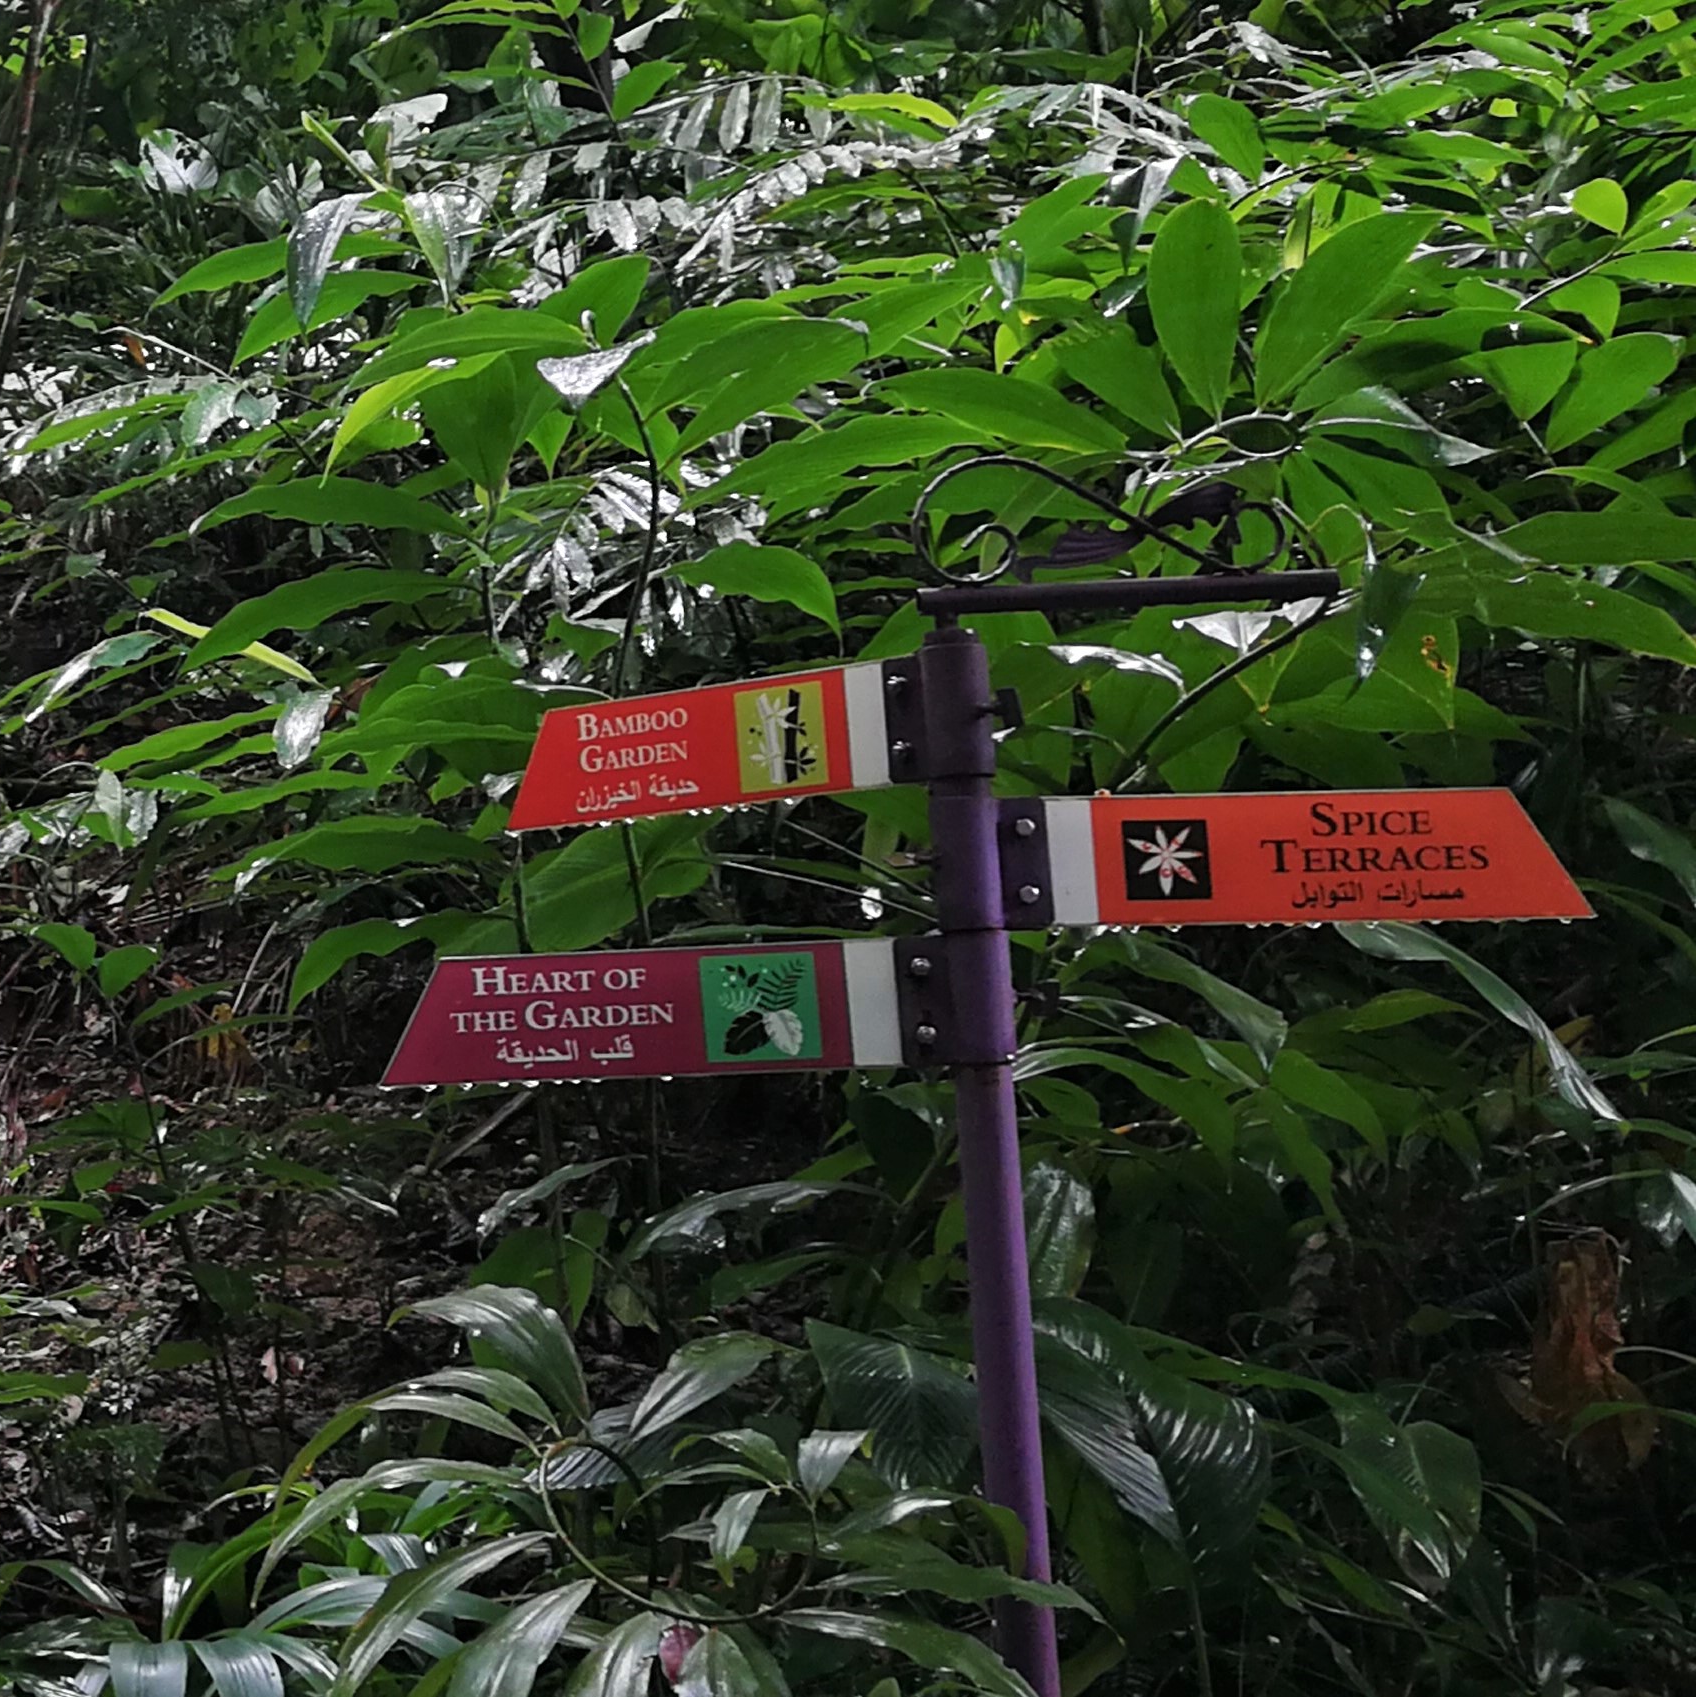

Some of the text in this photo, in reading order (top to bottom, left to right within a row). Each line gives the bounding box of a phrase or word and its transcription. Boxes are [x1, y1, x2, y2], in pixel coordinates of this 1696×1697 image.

[577, 708, 689, 741] BAMBOO
[580, 741, 688, 773] GARDEN
[575, 773, 700, 813] حديقة الخيزران
[1311, 802, 1432, 837] SPICE
[1260, 839, 1489, 873] TERRACES
[471, 966, 647, 996] HEART OF
[450, 1000, 674, 1033] THE GARDEN
[496, 1033, 635, 1070] قلب الحديقة
